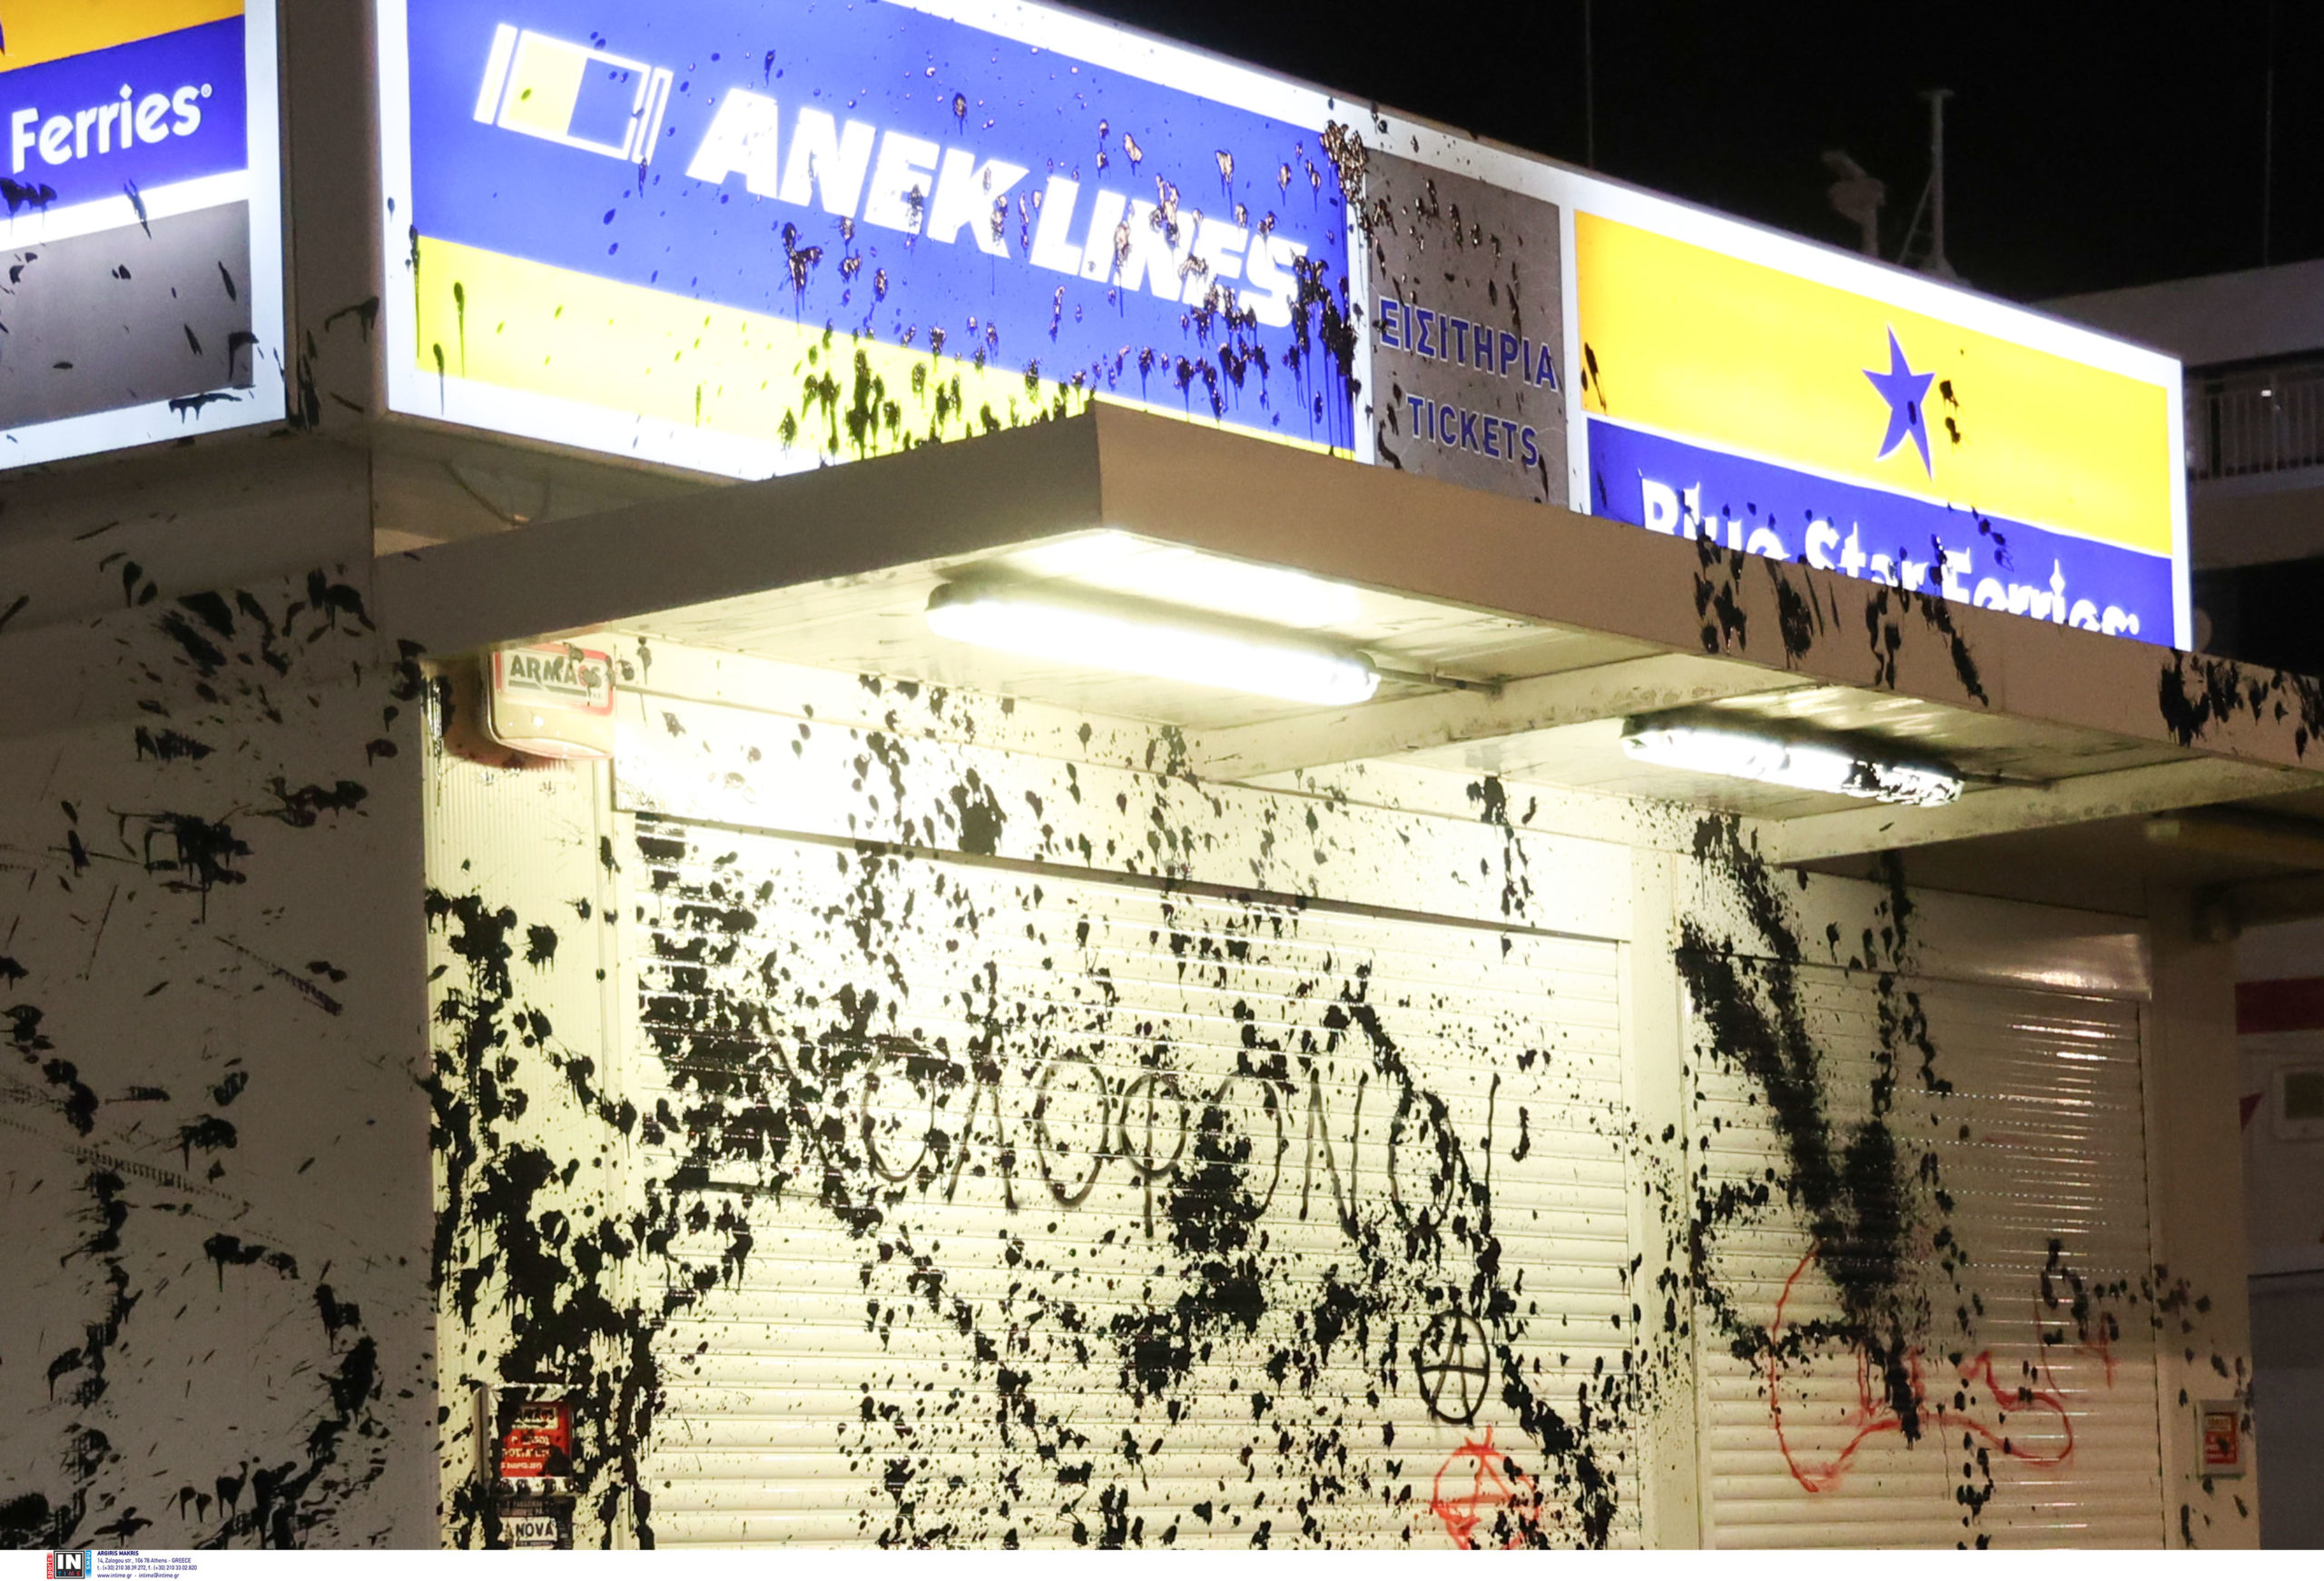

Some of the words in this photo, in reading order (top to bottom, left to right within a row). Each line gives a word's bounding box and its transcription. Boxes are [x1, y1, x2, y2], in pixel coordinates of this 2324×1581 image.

[686, 88, 1029, 258] ANEK
[1029, 175, 1309, 328] LINES
[1379, 296, 1559, 392] ΕΙΣΙΤΗΡΙΑ
[1405, 393, 1539, 467] TICKETS
